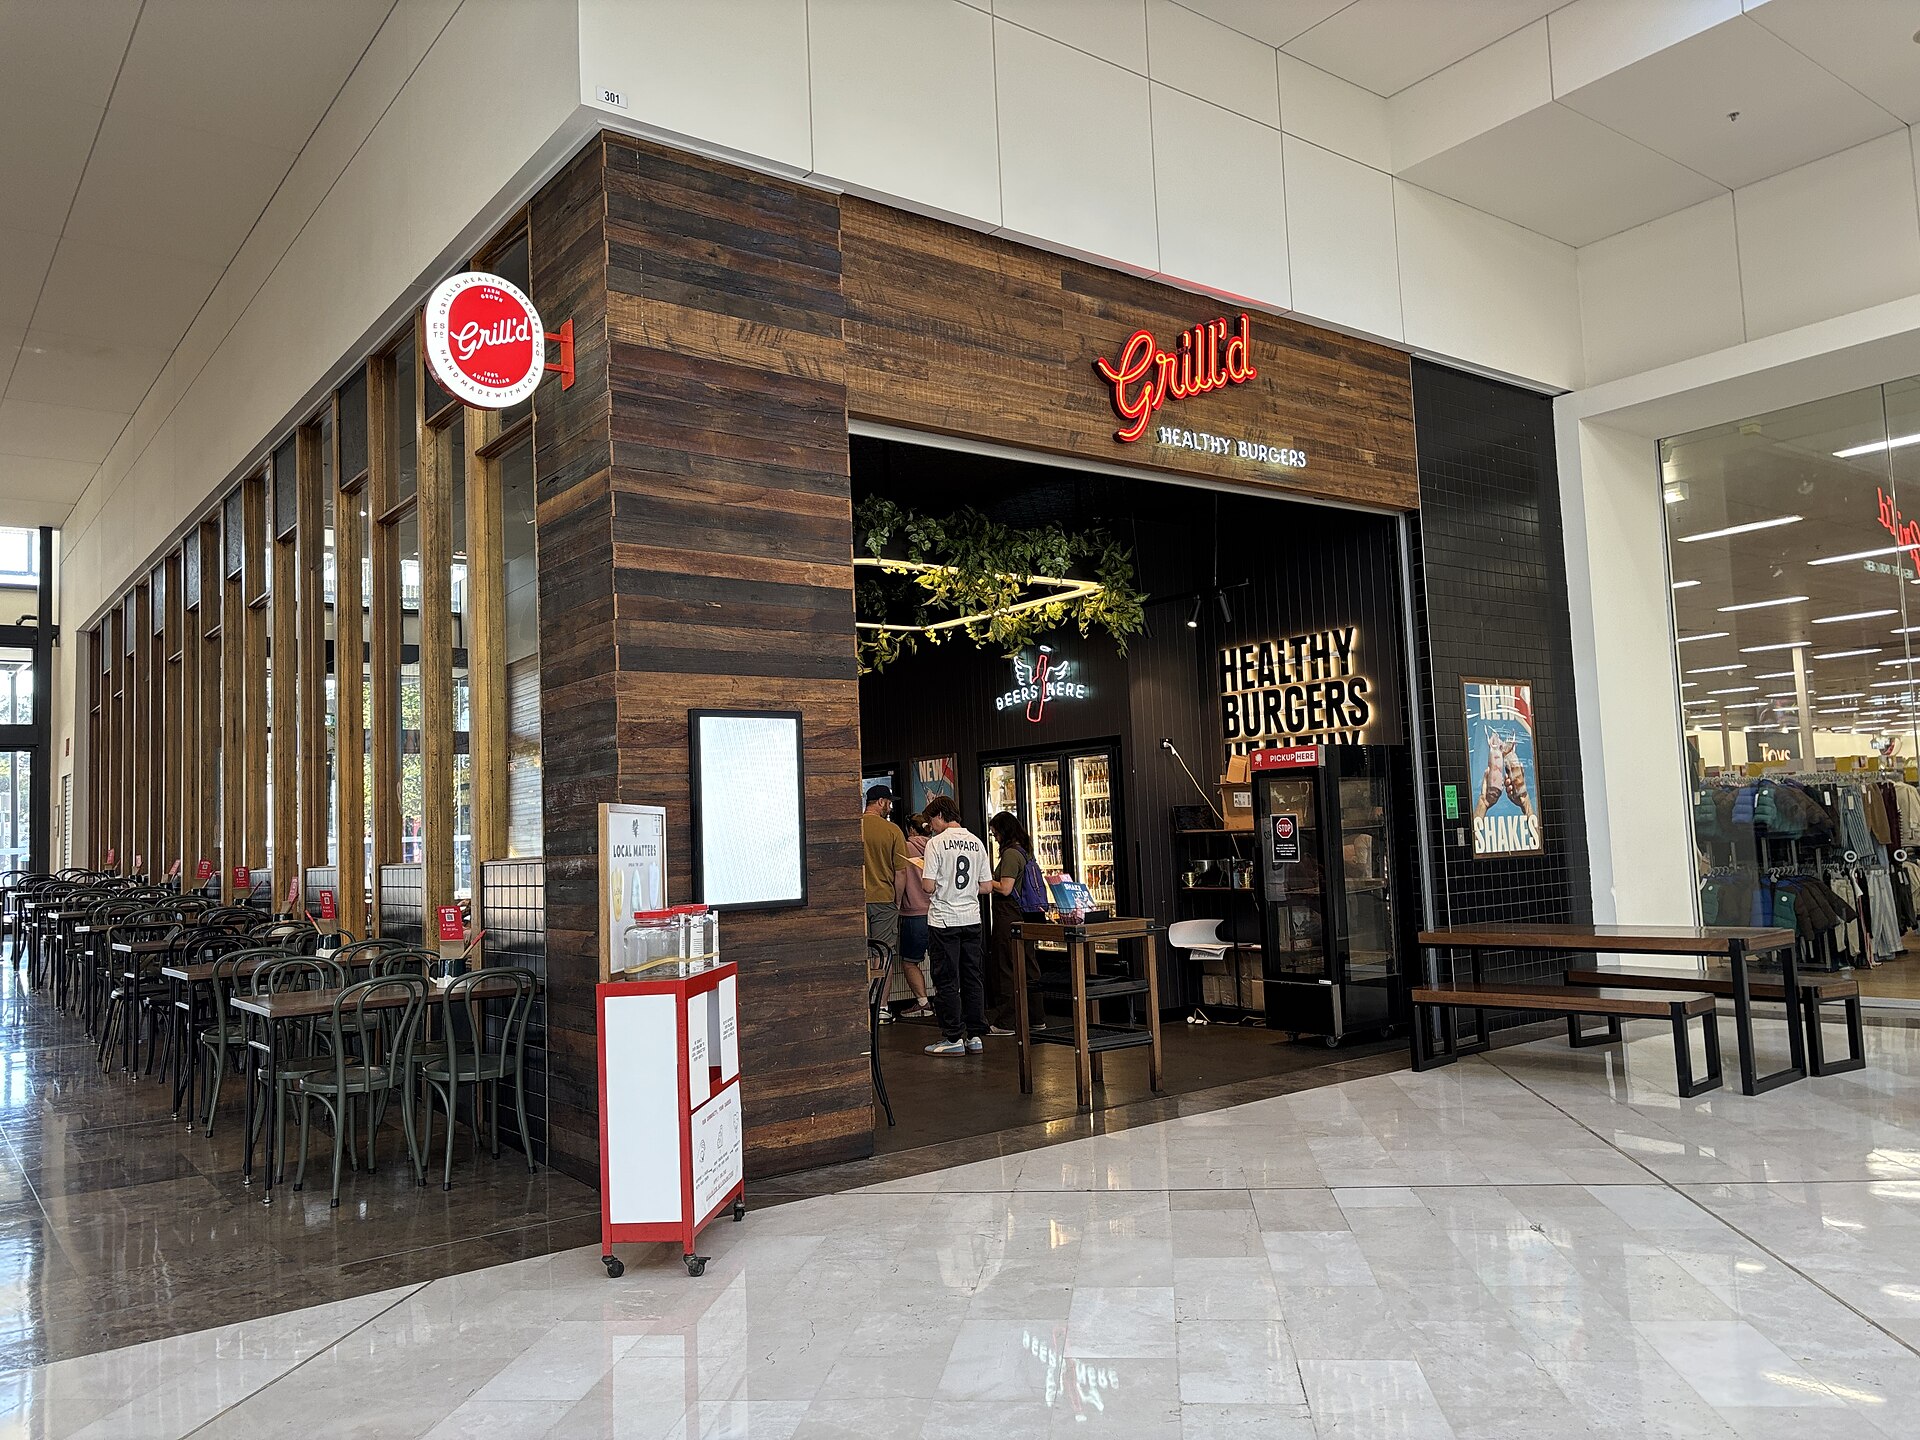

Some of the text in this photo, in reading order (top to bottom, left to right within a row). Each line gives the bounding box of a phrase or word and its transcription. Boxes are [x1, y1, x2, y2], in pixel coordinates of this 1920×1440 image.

[604, 90, 620, 104] 301
[462, 276, 511, 289] HEALTHY
[480, 293, 504, 303] GROWN
[449, 317, 532, 361] Grill'd
[460, 379, 491, 397] MADE
[495, 387, 521, 398] WITH
[522, 366, 539, 389] LOVE
[472, 372, 510, 385] AUSTRALIAN
[1093, 313, 1258, 442] Grill'd
[1158, 426, 1307, 468] HEALTHY BURGERS
[1219, 628, 1354, 693] HEALTHY
[995, 682, 1086, 711] BEERS HERE
[1221, 677, 1369, 739] BURGERS
[1478, 685, 1516, 721] NEW
[918, 758, 943, 783] NEW
[1269, 752, 1314, 762] PICKUP HERE
[1278, 823, 1291, 833] STOP
[1473, 814, 1540, 854] SHAKES
[613, 844, 657, 858] LOCAL MATTERS
[943, 839, 980, 852] LAMPARD
[954, 855, 970, 890] 8
